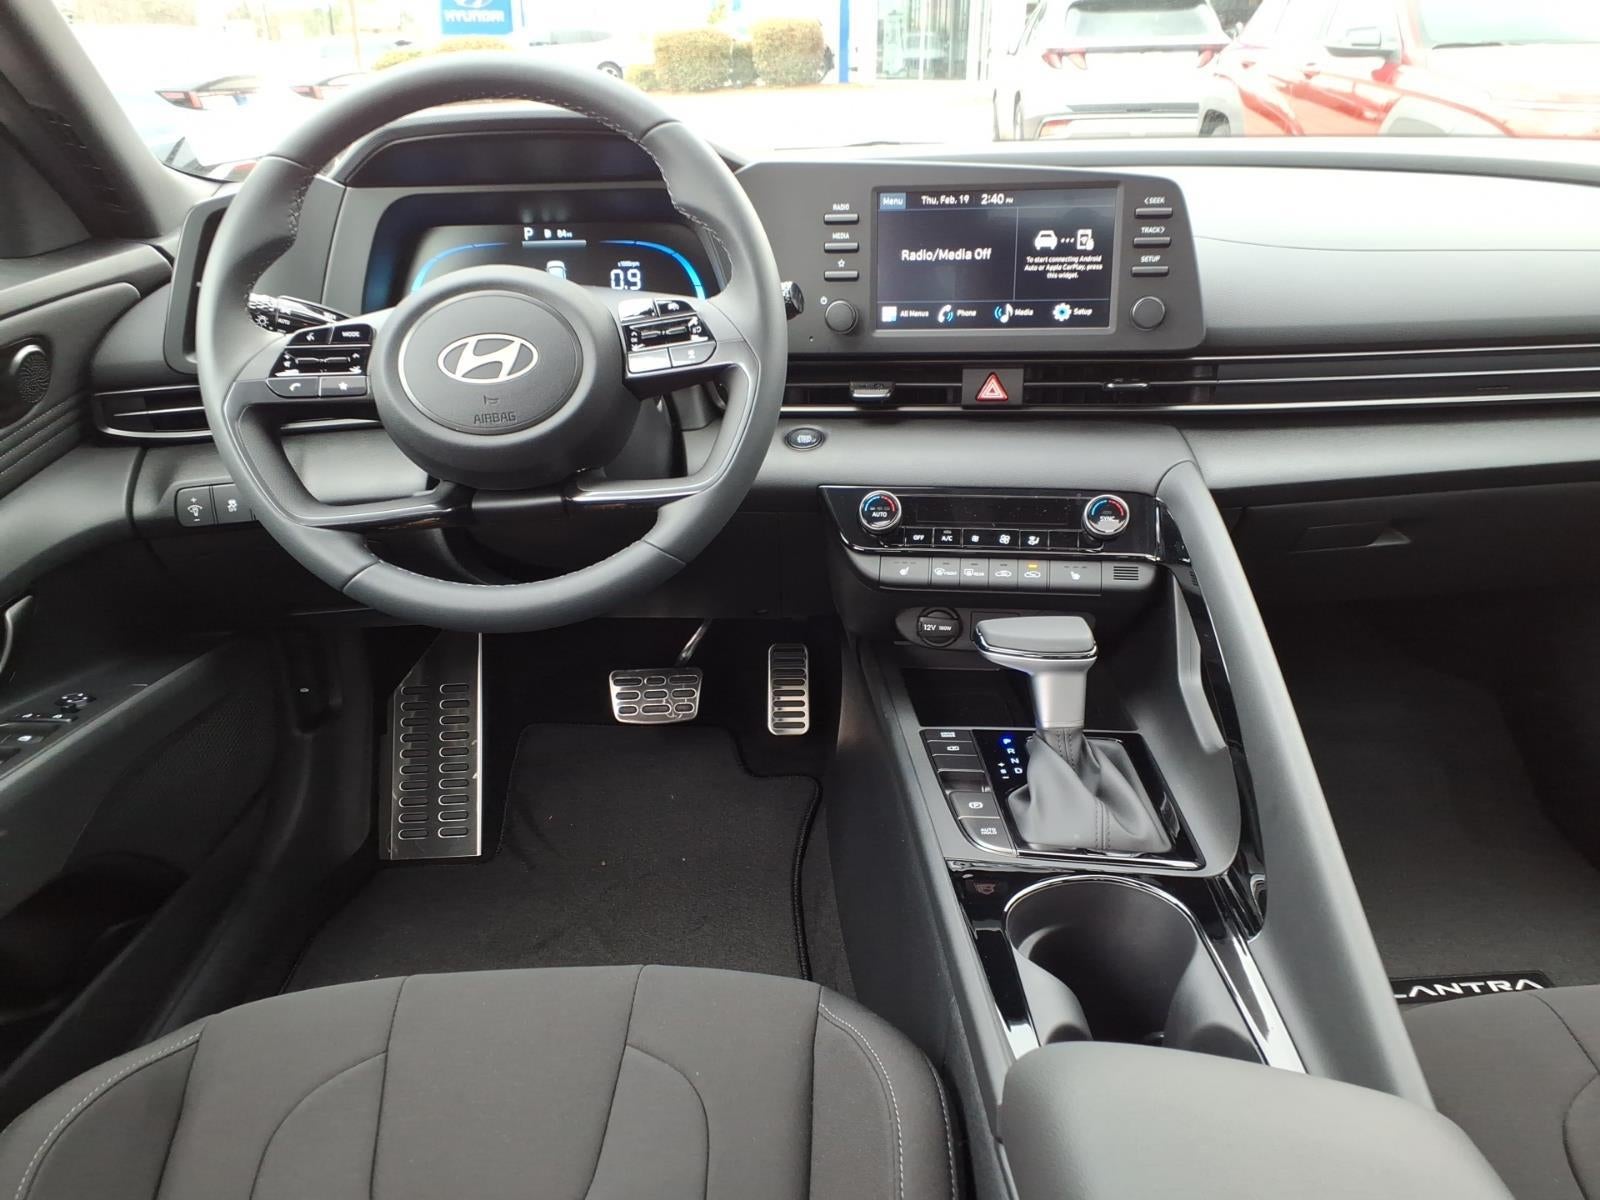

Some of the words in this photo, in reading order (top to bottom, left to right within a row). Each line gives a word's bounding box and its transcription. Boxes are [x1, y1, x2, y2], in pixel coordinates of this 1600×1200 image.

[443, 9, 505, 23] HYUNDAI
[883, 196, 903, 206] Menu
[921, 195, 939, 206] Thu,
[960, 194, 970, 205] 19
[981, 193, 1005, 205] 2:40
[524, 226, 534, 241] P
[832, 232, 850, 240] MEDIA
[901, 248, 972, 262] Radio/Media
[974, 247, 992, 260] Off
[1080, 254, 1102, 262] Android
[1140, 255, 1160, 263] SETUP
[610, 269, 642, 291] 0.9
[957, 309, 977, 317] Phone
[1073, 308, 1093, 316] Setup
[473, 411, 517, 425] AIRBAG
[941, 534, 953, 542] A/C
